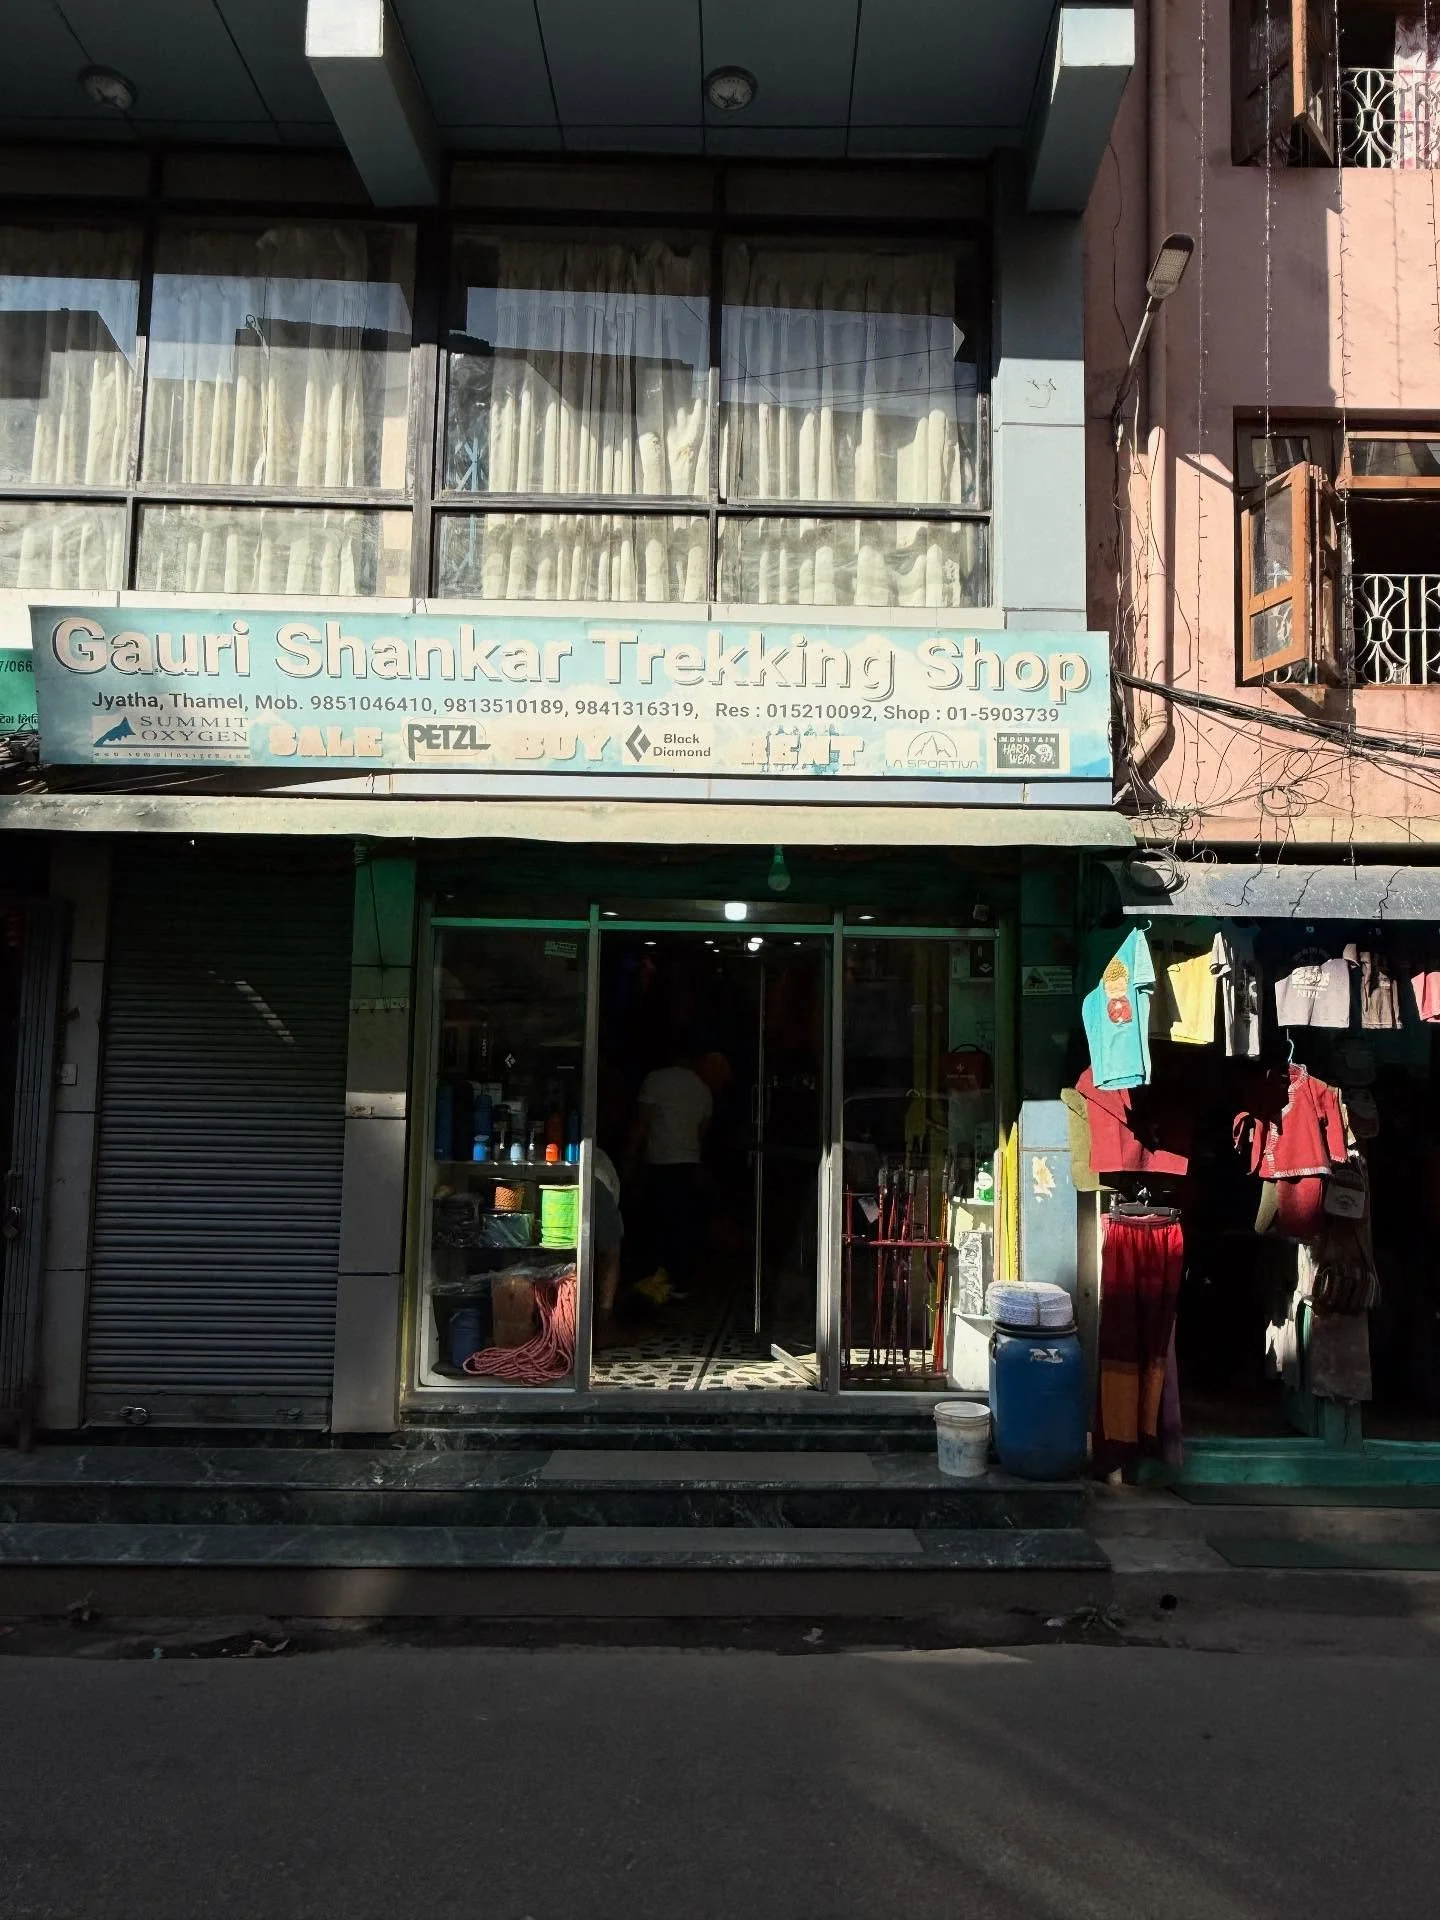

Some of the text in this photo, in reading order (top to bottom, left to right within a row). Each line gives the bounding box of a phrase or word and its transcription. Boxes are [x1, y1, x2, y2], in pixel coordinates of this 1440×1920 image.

[52, 616, 1092, 705] Gauri Shankar Trekking Shop
[92, 691, 164, 711] Jyatha,
[168, 693, 249, 712] Thamel,
[255, 694, 303, 710] Mob.
[310, 695, 437, 715] 9851046410,
[443, 698, 569, 718] 9813510189,
[575, 700, 699, 720] 9841316319,
[715, 702, 750, 718] Res
[766, 703, 877, 722] 015210092,
[883, 705, 930, 723] Shop
[946, 706, 1059, 722] 01-5903739
[140, 716, 249, 728] SUMMIT
[141, 730, 248, 742] OXYGEN
[268, 725, 384, 757] SALE
[663, 733, 700, 744] Black
[407, 723, 492, 762] PETZL
[514, 727, 612, 762] BUY
[653, 746, 711, 757] Diamond
[1002, 743, 1030, 755] HARD
[885, 759, 979, 769] LA SPORTIVA
[1009, 753, 1037, 765] WEAR
